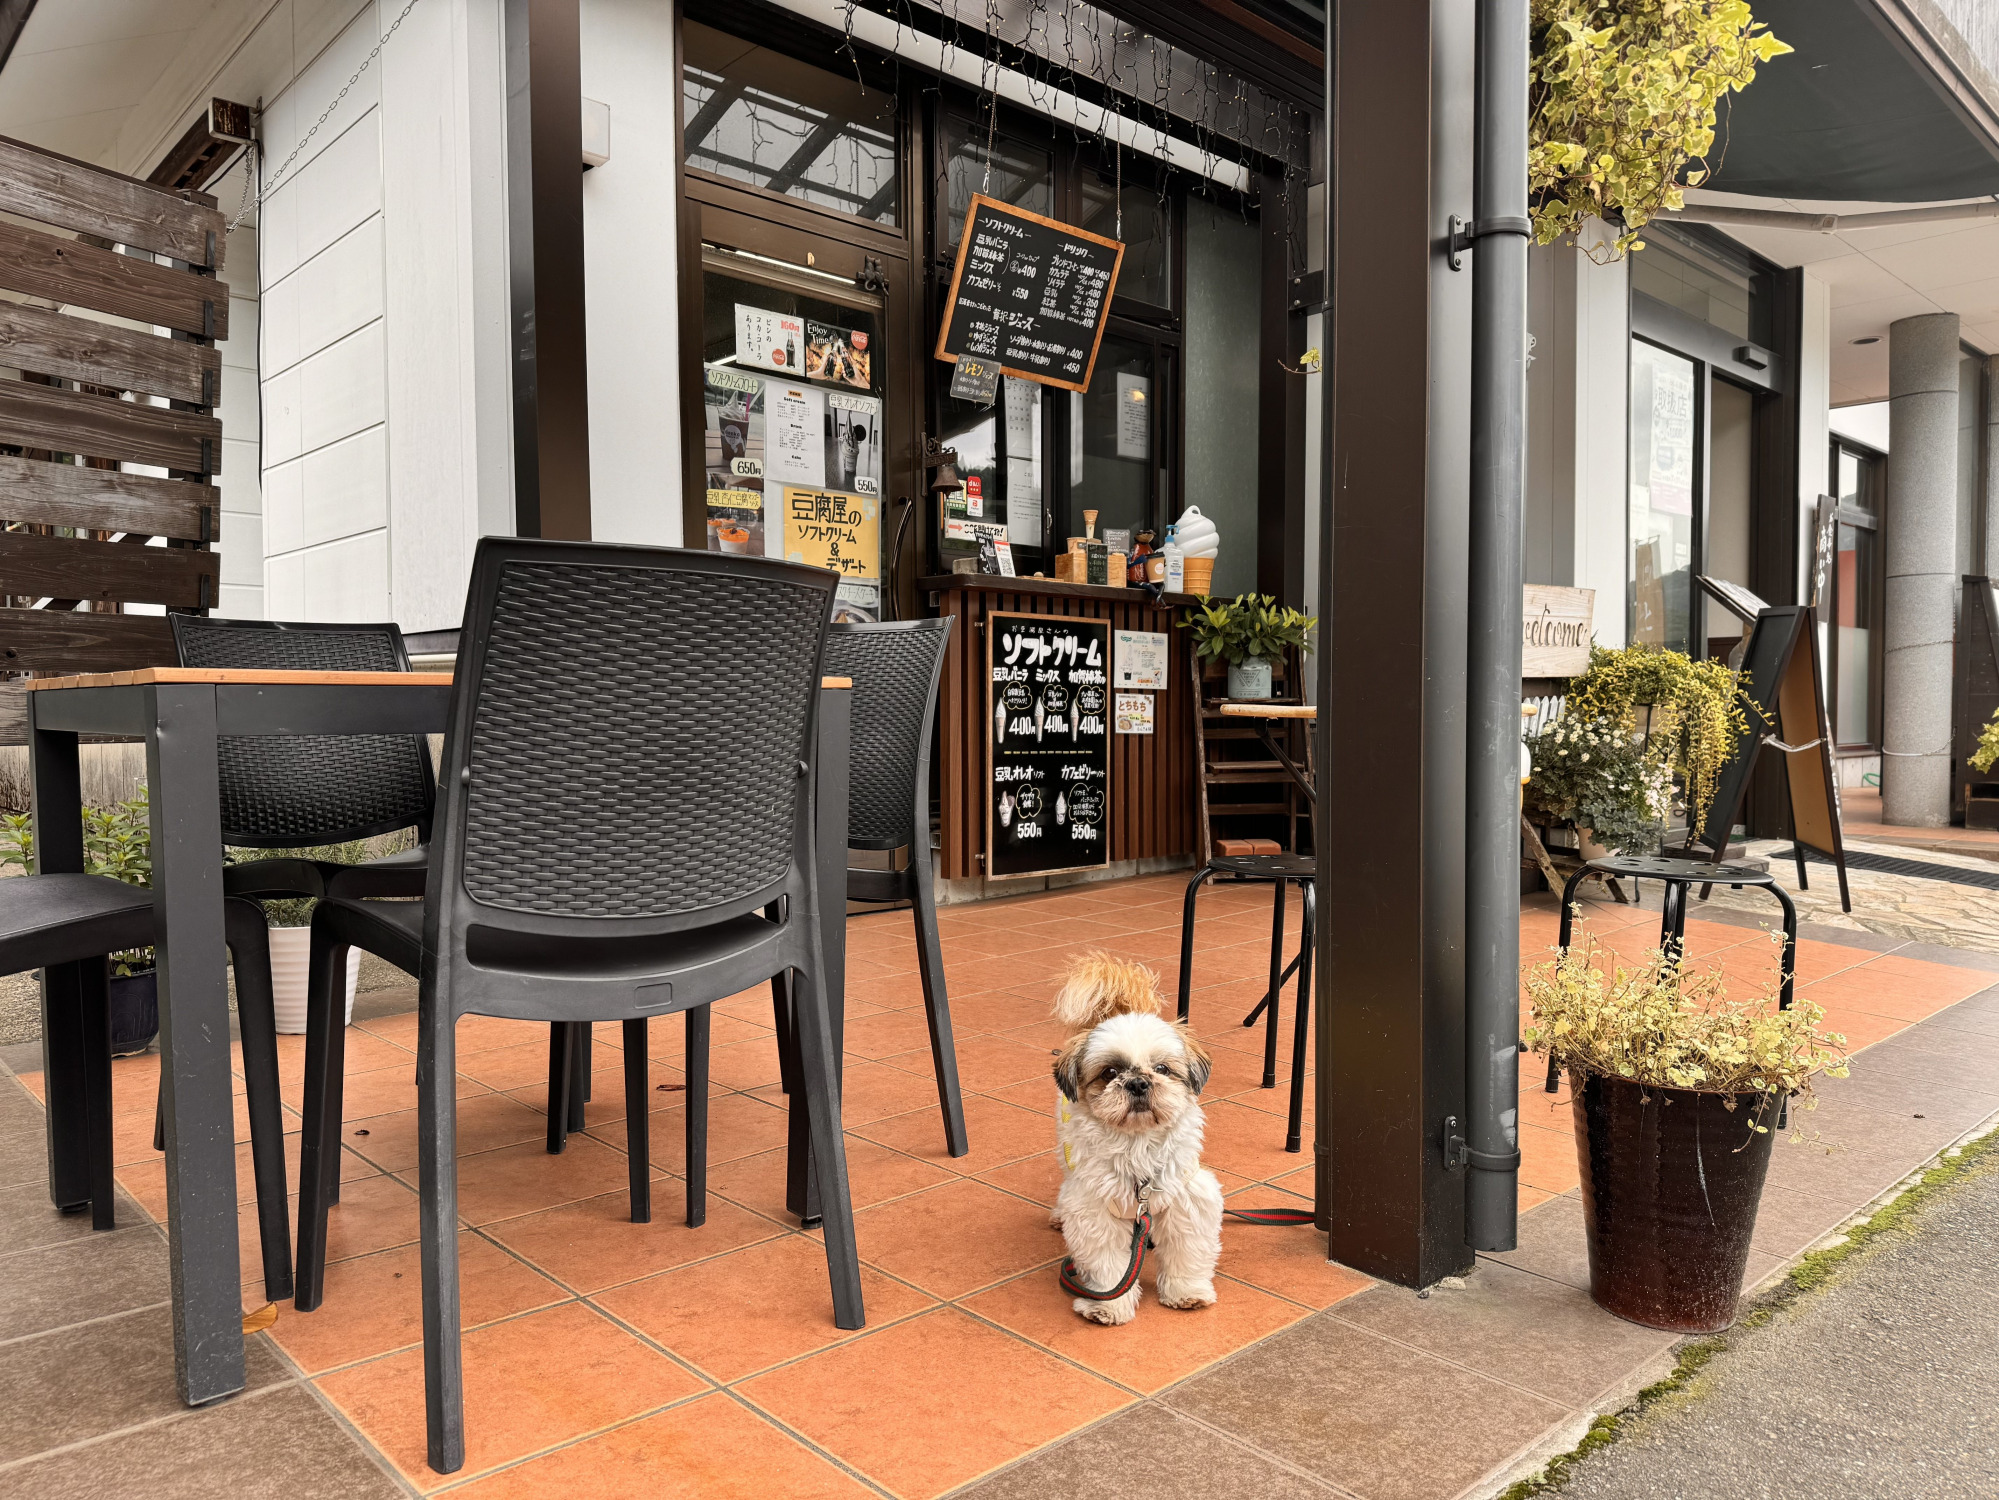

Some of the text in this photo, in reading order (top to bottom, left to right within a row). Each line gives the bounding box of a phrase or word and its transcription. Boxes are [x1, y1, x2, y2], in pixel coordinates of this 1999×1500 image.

[985, 217, 1024, 238] ソフトクリーム
[976, 233, 1009, 250] 豆乳バニラ
[1064, 243, 1088, 258] ドリンク
[970, 258, 995, 274] ミックス
[1049, 267, 1069, 279] カフェラテ
[1044, 286, 1058, 298] 豆乳
[807, 323, 828, 336] Enjoy
[811, 334, 829, 344] Time
[1656, 386, 1688, 419] 取扱店
[737, 461, 762, 475] 650円
[857, 479, 878, 493] 550円
[791, 492, 862, 527] 豆腐屋の
[798, 524, 857, 545] ソフトクリーム
[830, 541, 840, 557] &
[826, 557, 866, 574] デザート
[1002, 633, 1102, 667] ソフトクリーム
[993, 665, 1029, 682] 豆乳バニラ
[1035, 668, 1061, 683] ミックス
[1118, 700, 1147, 712] とちもち
[1009, 715, 1104, 735] 400円 400円 400円
[1017, 822, 1097, 840] 550円 550円
